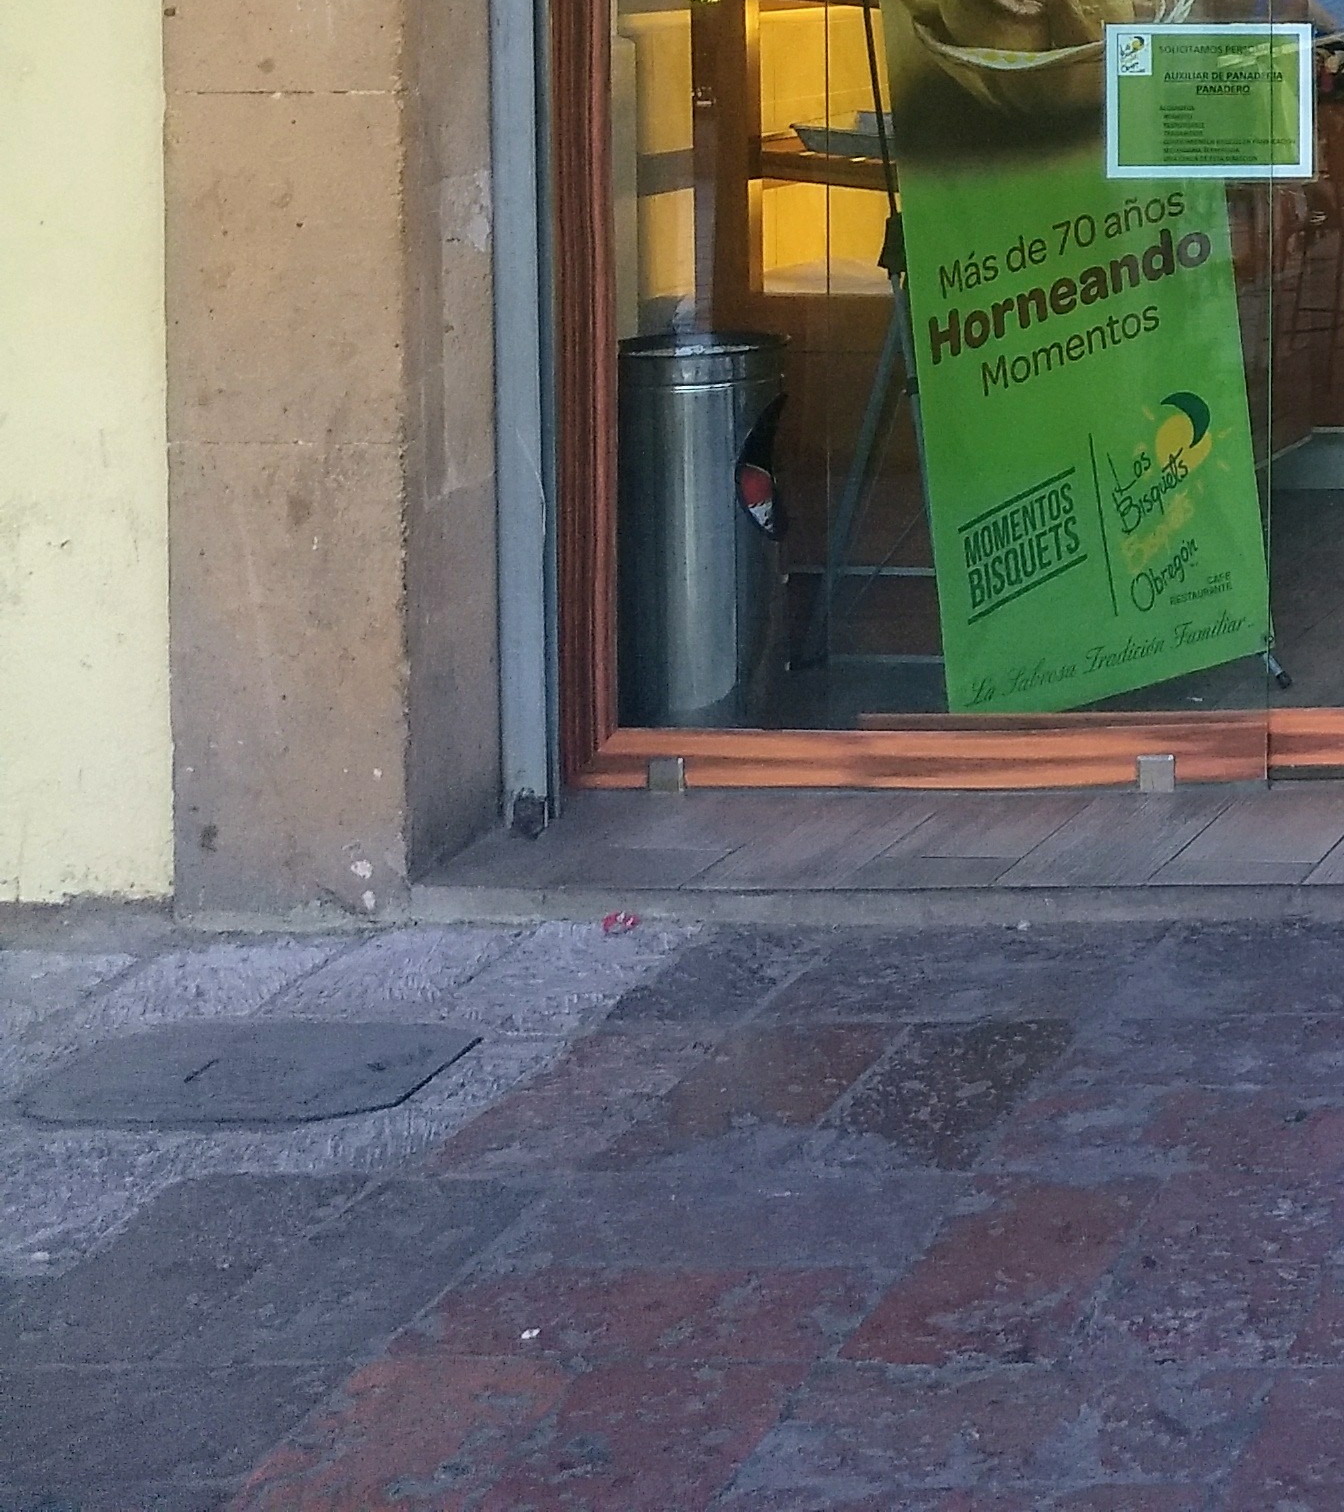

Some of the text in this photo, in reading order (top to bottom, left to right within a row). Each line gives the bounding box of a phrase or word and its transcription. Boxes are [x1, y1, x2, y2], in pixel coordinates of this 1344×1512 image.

[1164, 71, 1283, 81] AUXILIAR DE PANADRIA
[1196, 85, 1250, 94] PANADERO
[939, 191, 1186, 299] Más de 70 años
[928, 228, 1212, 366] Horneando
[981, 304, 1160, 396] Momentos
[1107, 451, 1151, 496] Los
[1112, 447, 1189, 535] Bisquets
[963, 482, 1075, 569] MOMENTOS
[968, 516, 1081, 612] BISQUETS
[1082, 636, 1165, 675] Tradición
